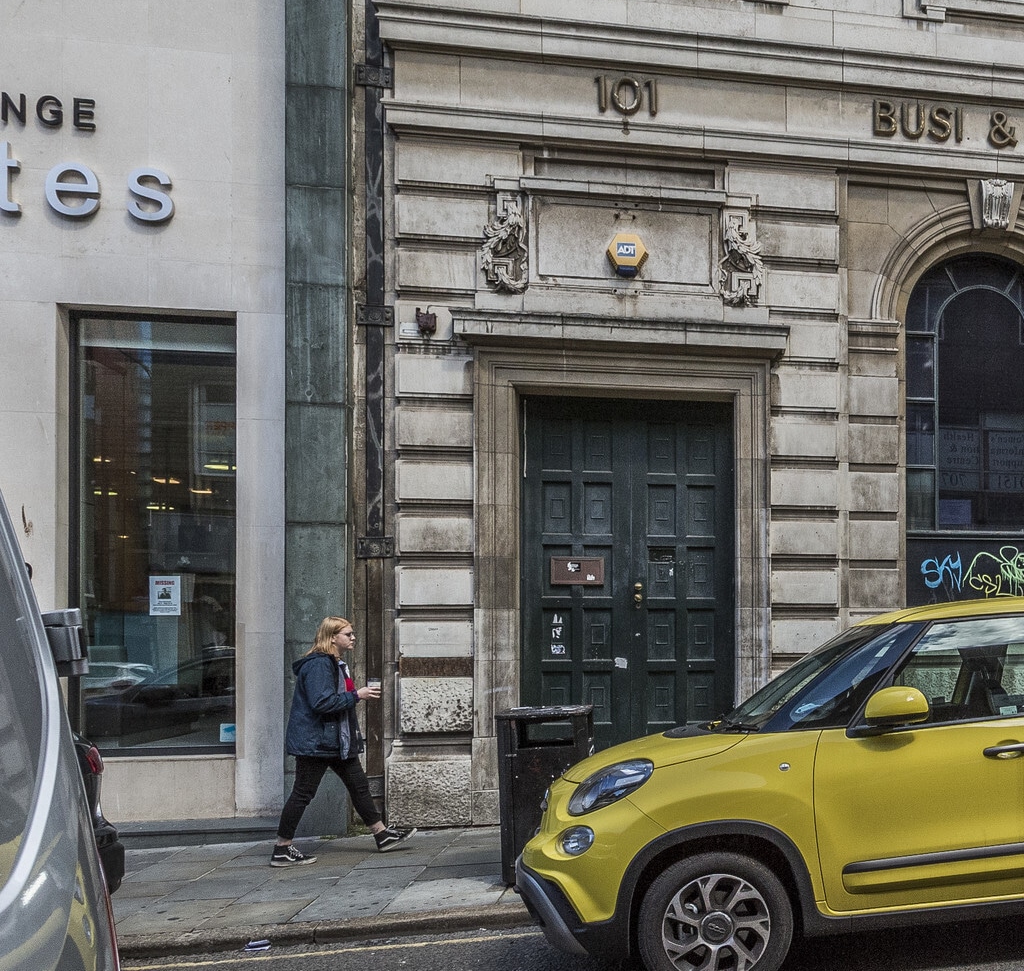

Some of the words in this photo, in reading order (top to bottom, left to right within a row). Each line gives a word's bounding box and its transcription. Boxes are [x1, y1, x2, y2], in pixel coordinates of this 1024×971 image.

[1, 91, 97, 131] NGE
[594, 74, 659, 116] 101
[873, 98, 964, 143] BUSI
[990, 111, 1018, 148] &
[0, 140, 175, 223] tes
[617, 245, 637, 255] ADT
